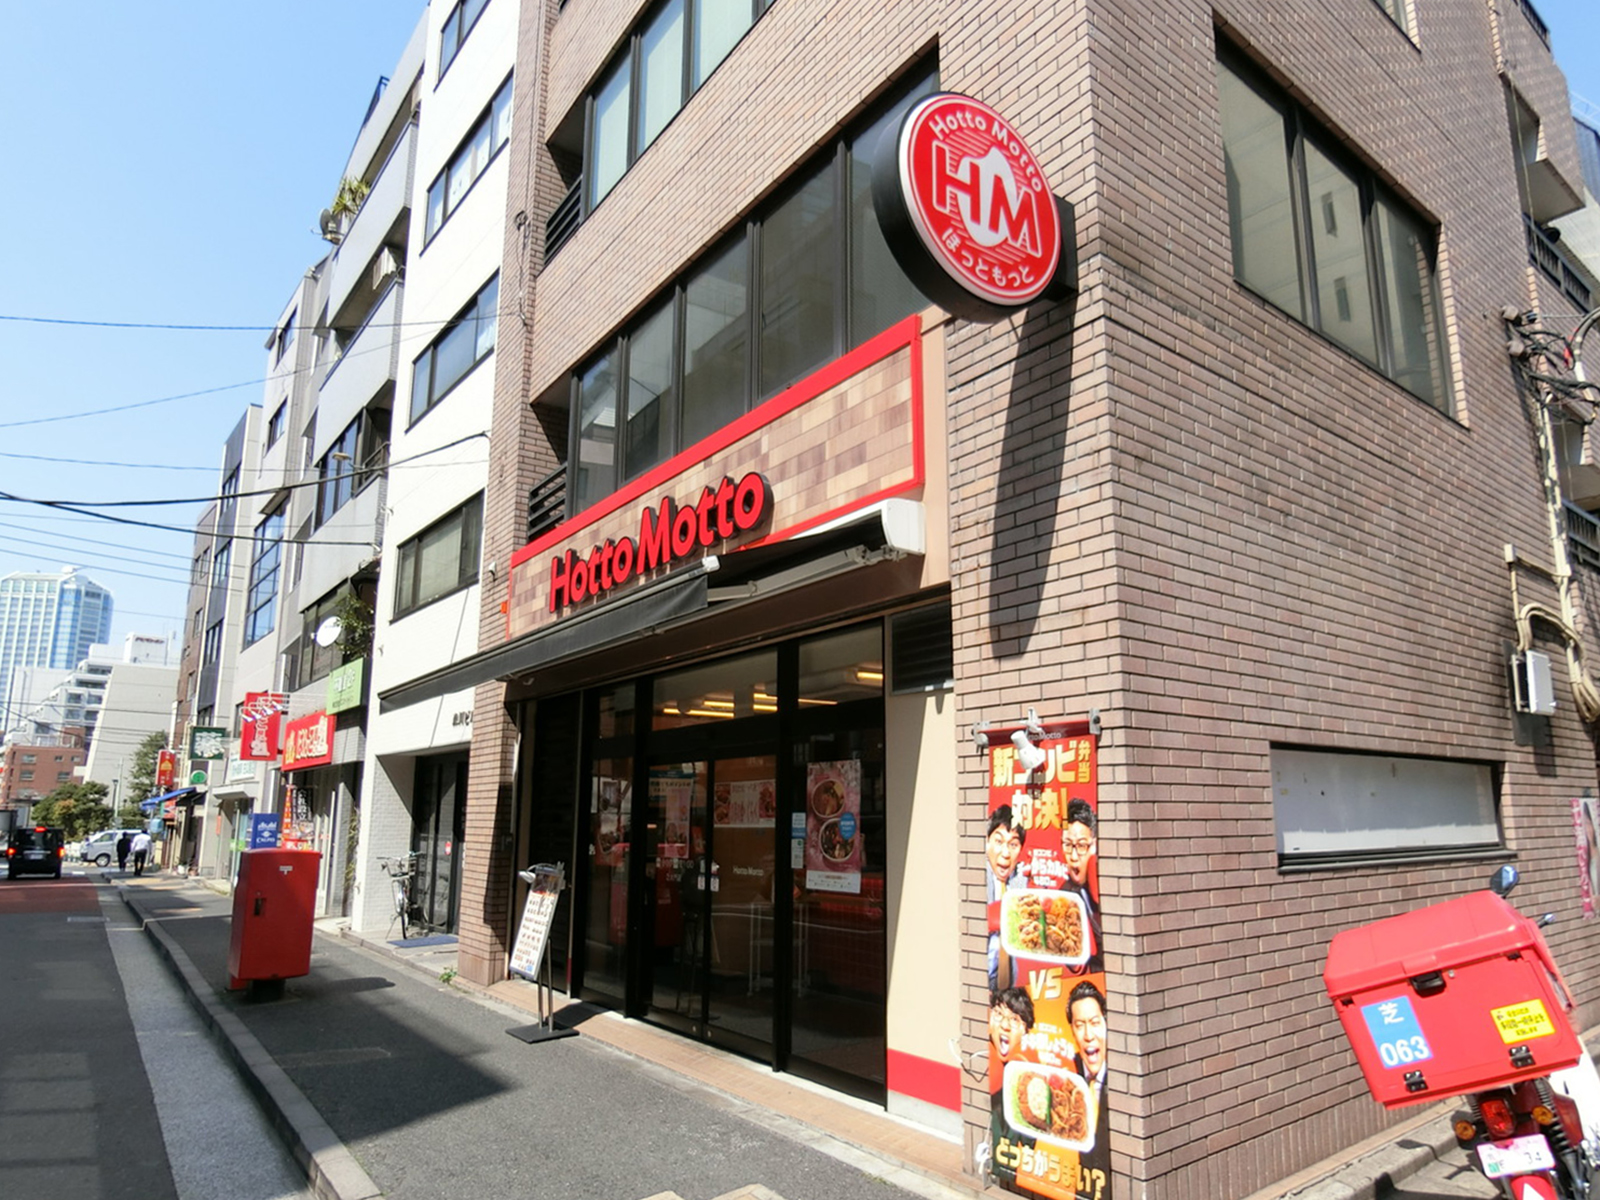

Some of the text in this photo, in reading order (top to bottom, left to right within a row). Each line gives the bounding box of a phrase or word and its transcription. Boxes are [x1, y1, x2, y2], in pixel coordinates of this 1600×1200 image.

[929, 110, 1042, 193] Hotto Motto
[942, 228, 1035, 288] ほっともっと
[1029, 966, 1063, 1000] VS
[1378, 1002, 1404, 1025] 芝
[1380, 1035, 1430, 1066] 063
